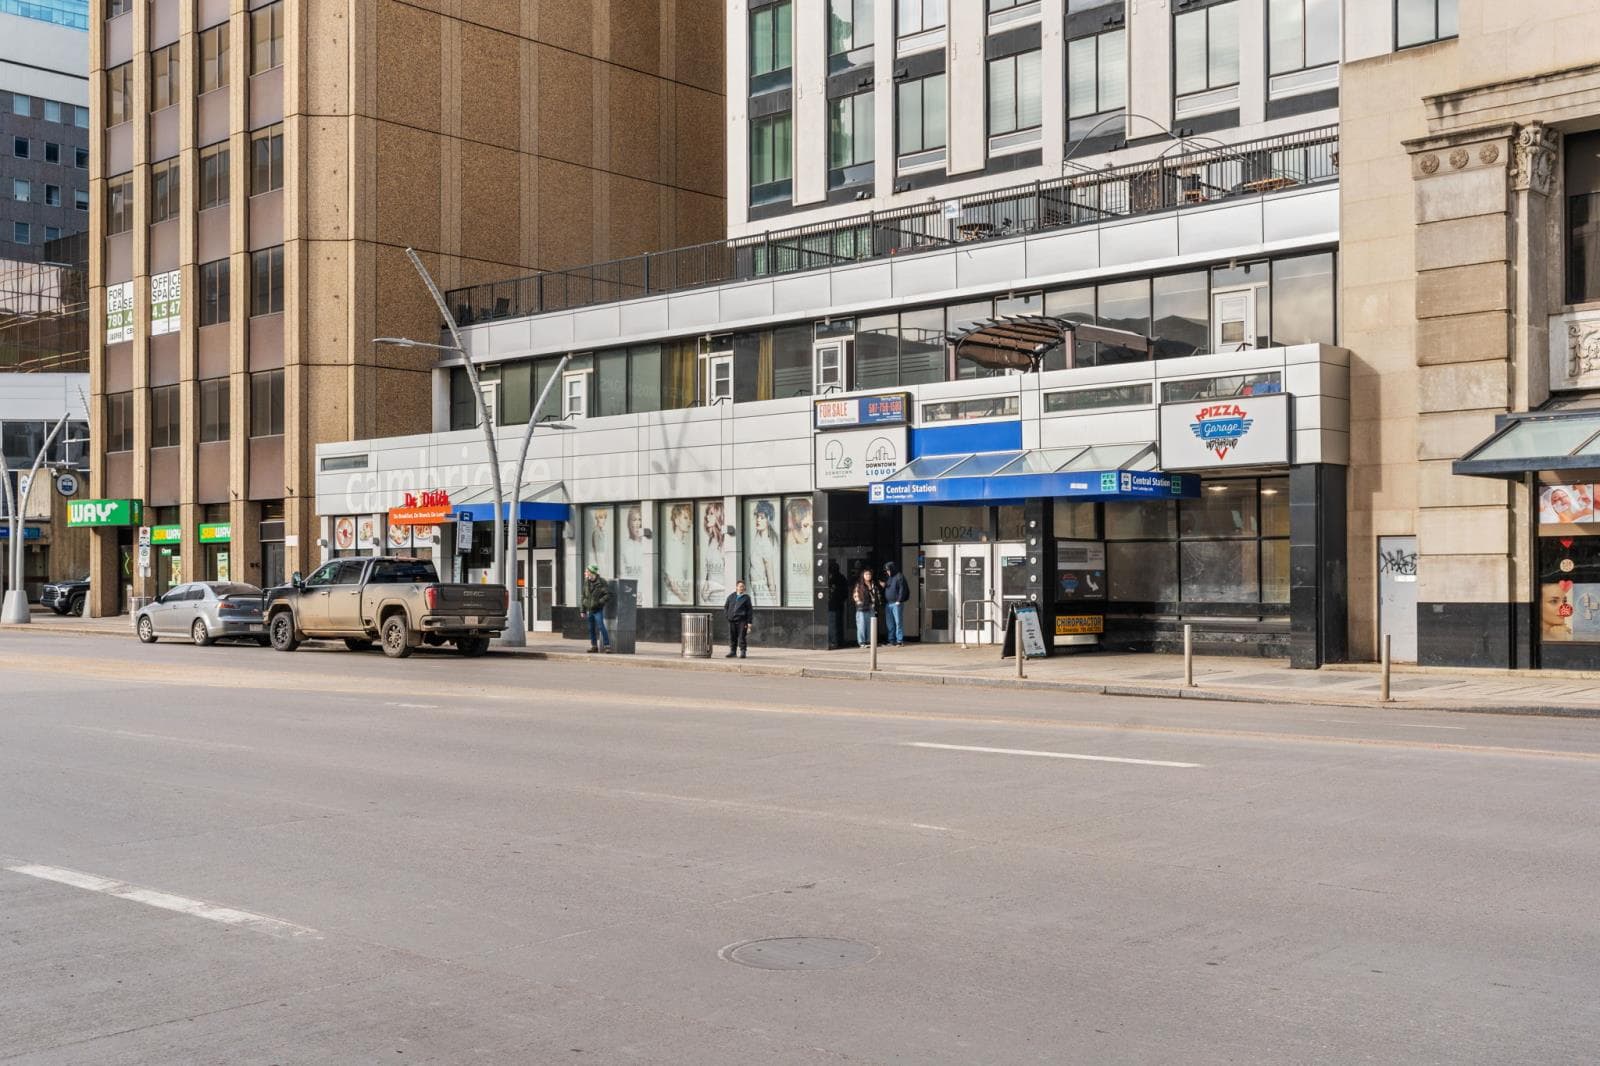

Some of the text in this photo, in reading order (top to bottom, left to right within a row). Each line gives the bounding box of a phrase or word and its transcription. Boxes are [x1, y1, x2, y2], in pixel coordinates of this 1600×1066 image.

[152, 274, 182, 290] OFFICE
[108, 288, 122, 300] FOR
[152, 286, 180, 302] SPACE
[108, 297, 133, 312] LEASE
[819, 402, 848, 418] FOR SALE
[1198, 404, 1246, 420] PIZZA
[1204, 423, 1240, 437] Garage
[886, 483, 937, 494] Central Station
[1132, 475, 1151, 486] Central
[1152, 477, 1171, 488] Station
[404, 490, 449, 508] De Dutch
[939, 526, 973, 539] 10024
[1056, 617, 1102, 627] CHIROPRACTOR
